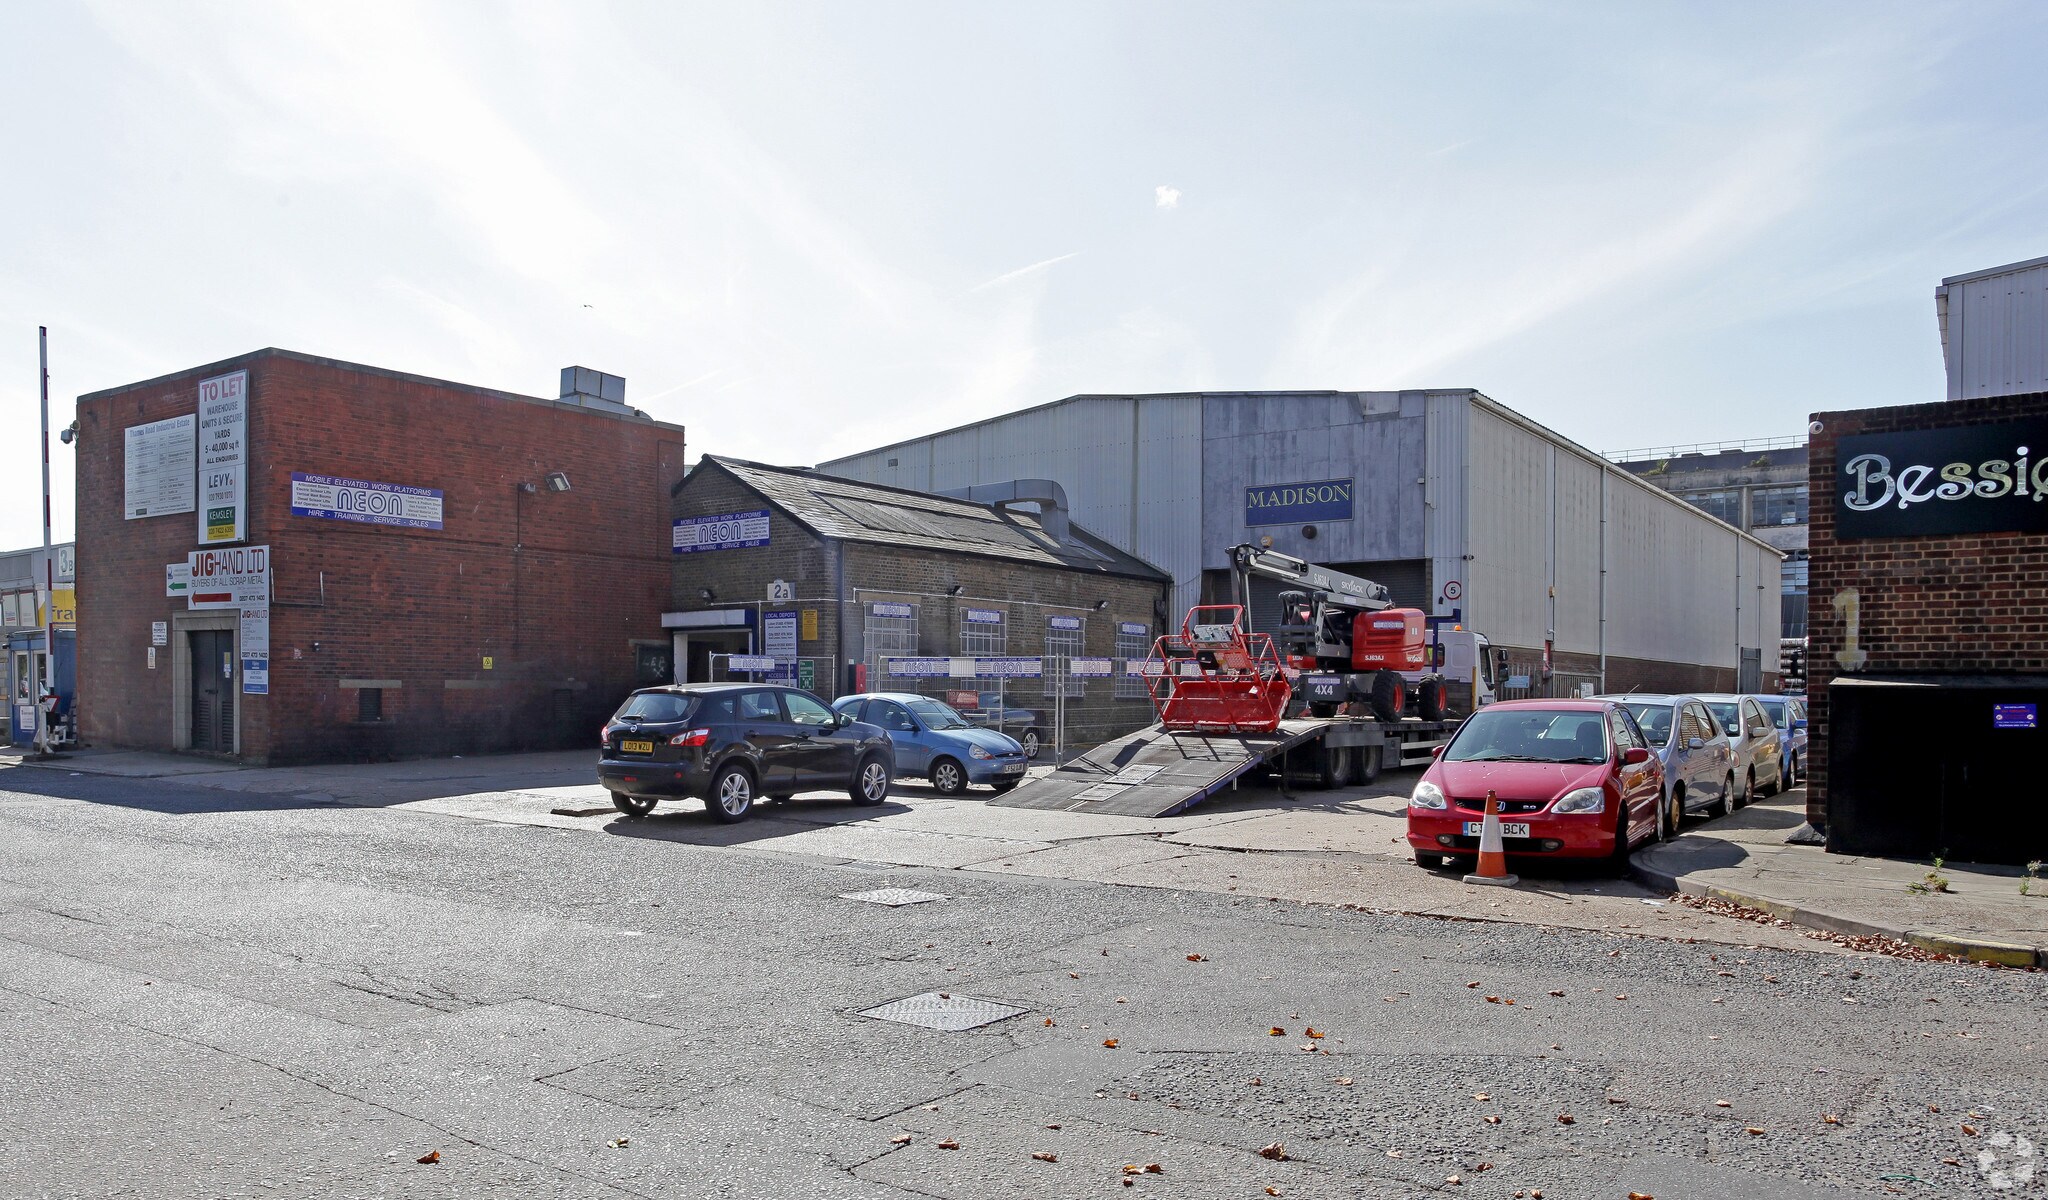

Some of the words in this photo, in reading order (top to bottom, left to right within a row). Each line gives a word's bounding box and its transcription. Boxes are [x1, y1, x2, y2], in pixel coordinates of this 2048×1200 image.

[202, 382, 218, 402] TO
[222, 376, 244, 398] LET
[206, 401, 238, 416] WAREHOUSE
[129, 428, 144, 438] Thames
[145, 424, 155, 434] Road
[156, 420, 176, 433] Industrial
[176, 418, 190, 428] Estate
[202, 418, 217, 429] UNITS
[223, 412, 243, 425] SECURE
[214, 429, 231, 439] YARDS
[229, 443, 234, 451] sq
[216, 454, 238, 463] ENQUIRIES
[209, 473, 230, 488] LEVY
[305, 475, 331, 484] MOBILE
[334, 479, 369, 488] ELEVATED
[371, 483, 392, 491] WORK
[394, 486, 432, 496] PLATFORMS
[1247, 484, 1351, 509] MADISON
[209, 509, 233, 520] KEMSLEY
[307, 509, 325, 517] HIRE
[333, 511, 365, 521] TRAINING
[373, 516, 401, 525] SERVICE
[409, 519, 429, 528] SALES
[697, 516, 720, 524] ELEVATED
[735, 511, 762, 520] PLATFORMS
[192, 550, 243, 577] JIGHAND
[247, 549, 265, 574] LTD
[192, 578, 210, 588] BUYERS
[211, 577, 218, 586] OF
[219, 577, 228, 586] ALL
[229, 576, 247, 586] SCRAP
[247, 575, 264, 585] METAL
[774, 584, 789, 599] 2a
[1833, 587, 1867, 671] 1
[1315, 685, 1333, 695] 4X4
[1503, 824, 1526, 835] BCK
